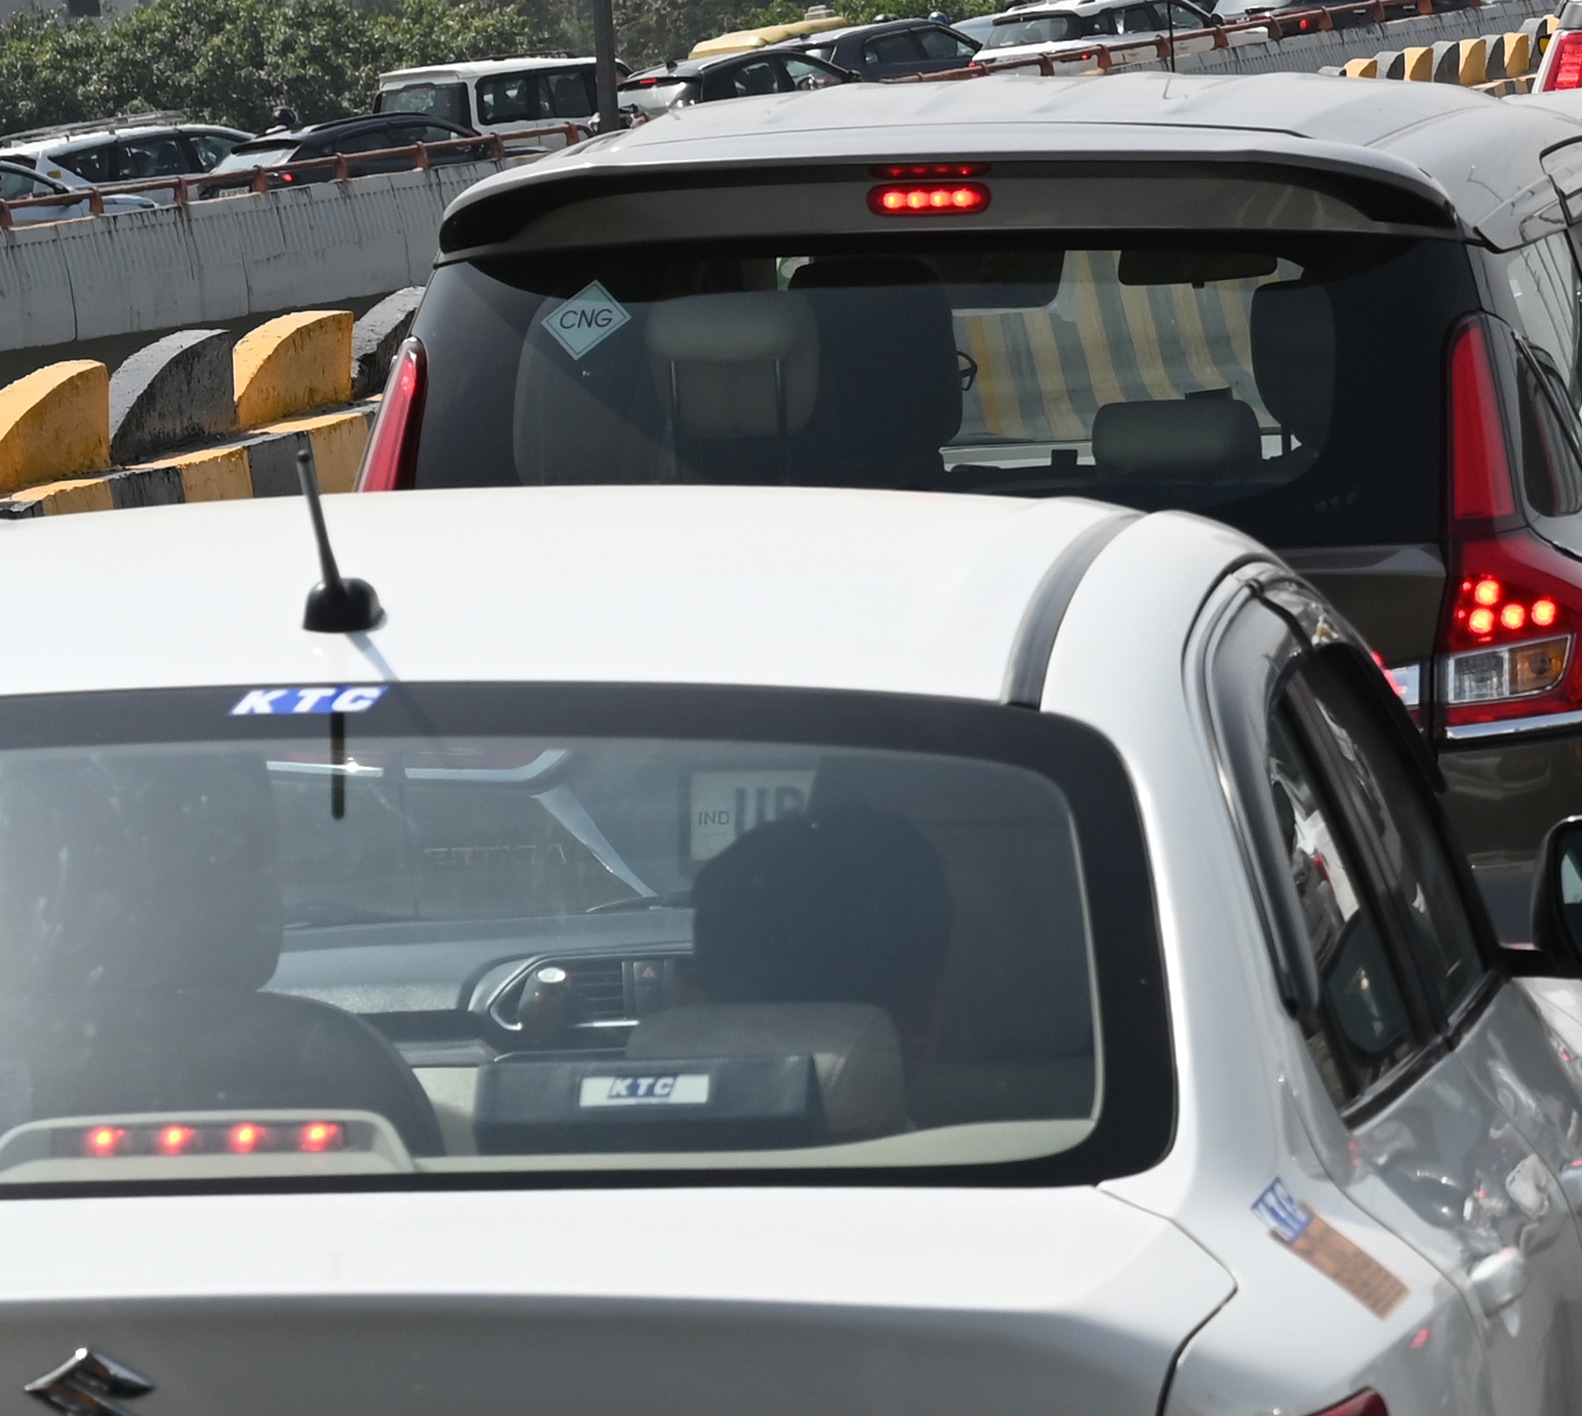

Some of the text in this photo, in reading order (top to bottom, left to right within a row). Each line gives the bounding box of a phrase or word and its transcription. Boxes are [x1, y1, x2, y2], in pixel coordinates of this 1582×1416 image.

[560, 308, 613, 330] CNG
[231, 686, 383, 716] KTC
[699, 810, 730, 826] IND
[610, 1077, 674, 1097] KTC
